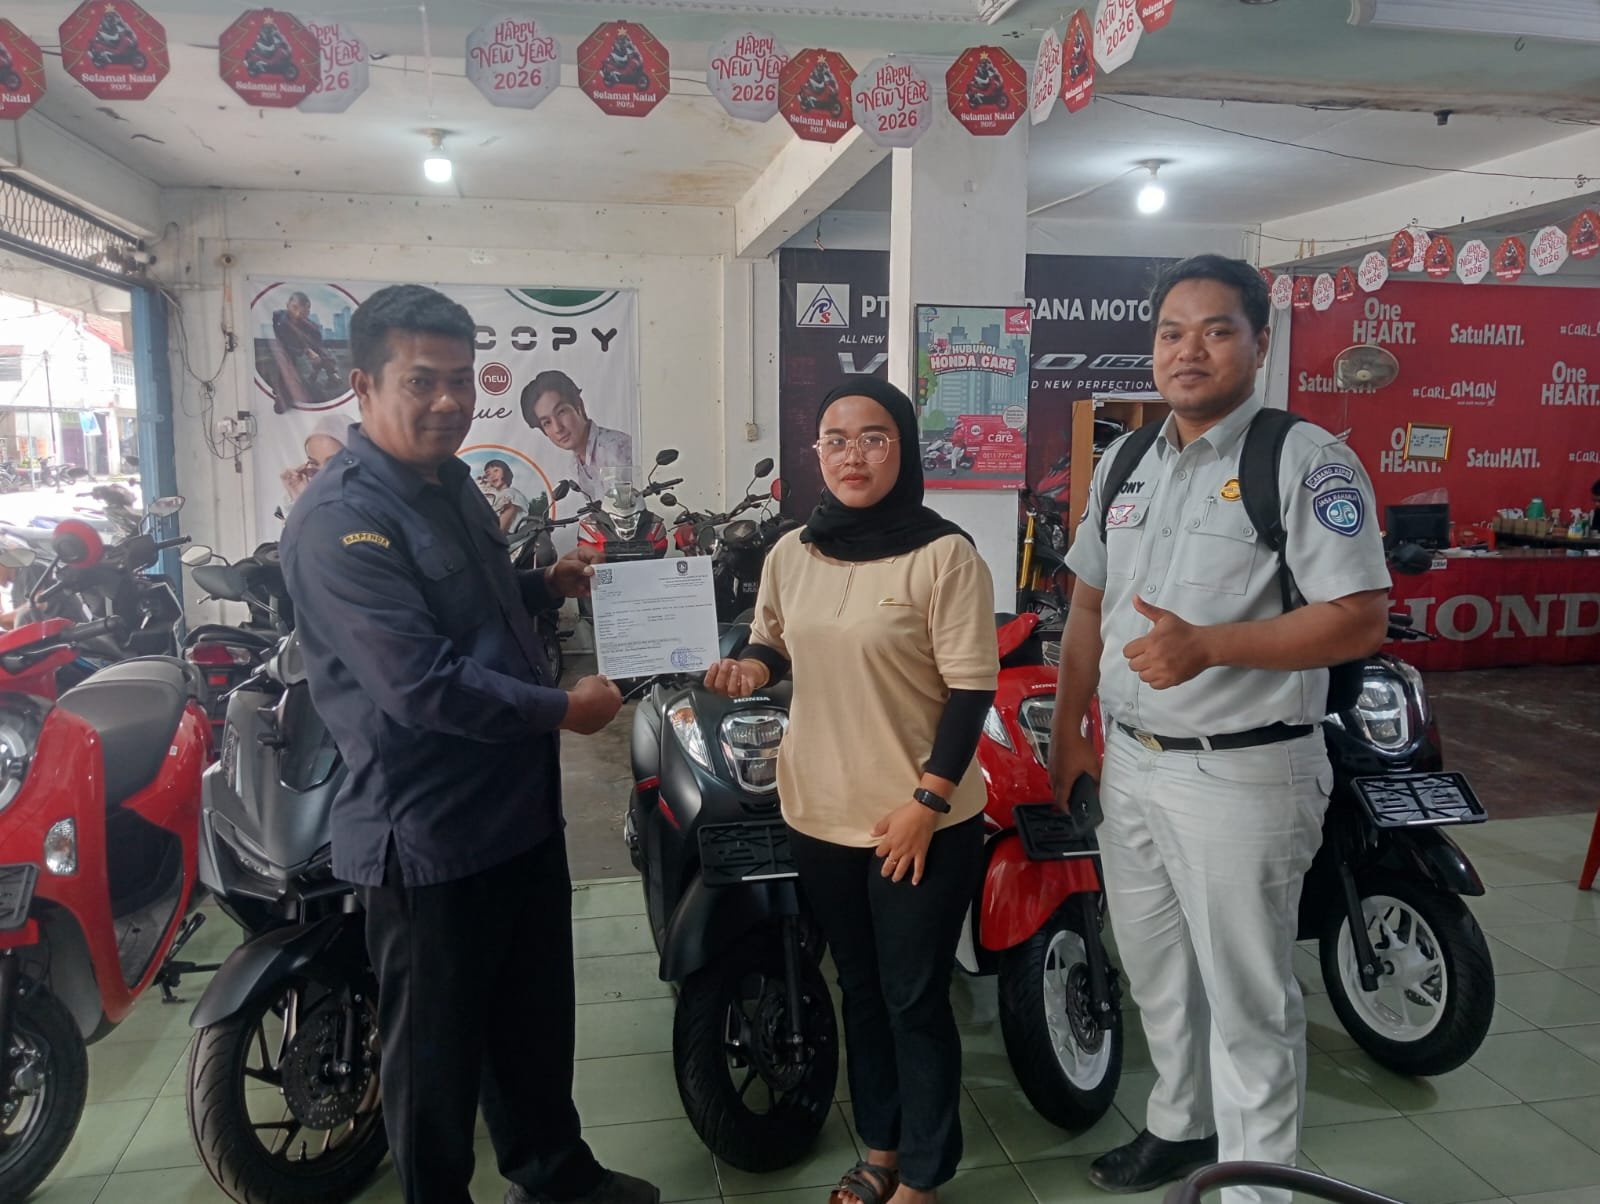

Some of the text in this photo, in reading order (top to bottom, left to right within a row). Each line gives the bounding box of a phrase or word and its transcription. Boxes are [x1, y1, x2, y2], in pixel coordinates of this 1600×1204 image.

[495, 20, 536, 43] HAPPY
[1106, 12, 1134, 56] 2026
[320, 39, 364, 73] YEAR
[470, 37, 557, 69] NEW YEAR
[735, 35, 775, 58] HAPPY
[81, 73, 157, 83] Selamat Natal
[712, 55, 753, 80] NEW
[876, 64, 913, 87] HAPPY
[235, 80, 306, 93] Selamat Natal
[493, 69, 542, 90] 2026
[2, 93, 31, 103] Natal
[592, 90, 657, 102] Selamat Natal
[732, 84, 776, 101] 2026
[856, 80, 929, 112] NEW YEAR
[789, 113, 848, 129] Selamat Natal
[878, 110, 918, 132] 2026
[960, 111, 1016, 121] Selamat Natal
[1464, 265, 1482, 277] 2026
[1539, 255, 1559, 267] 2026
[1366, 274, 1382, 286] 2026
[861, 295, 889, 318] PT
[1364, 297, 1401, 320] One
[838, 335, 885, 344] ALL NEW
[1352, 320, 1416, 345] HEART.
[1450, 323, 1525, 346] SatuHATI.
[952, 344, 996, 355] HUBUNGI
[930, 354, 1016, 371] HONDA CARE
[1552, 360, 1587, 383] One
[1044, 380, 1072, 389] NEW
[1076, 380, 1153, 390] PERFECTION
[1467, 447, 1541, 468] SatuHATI.
